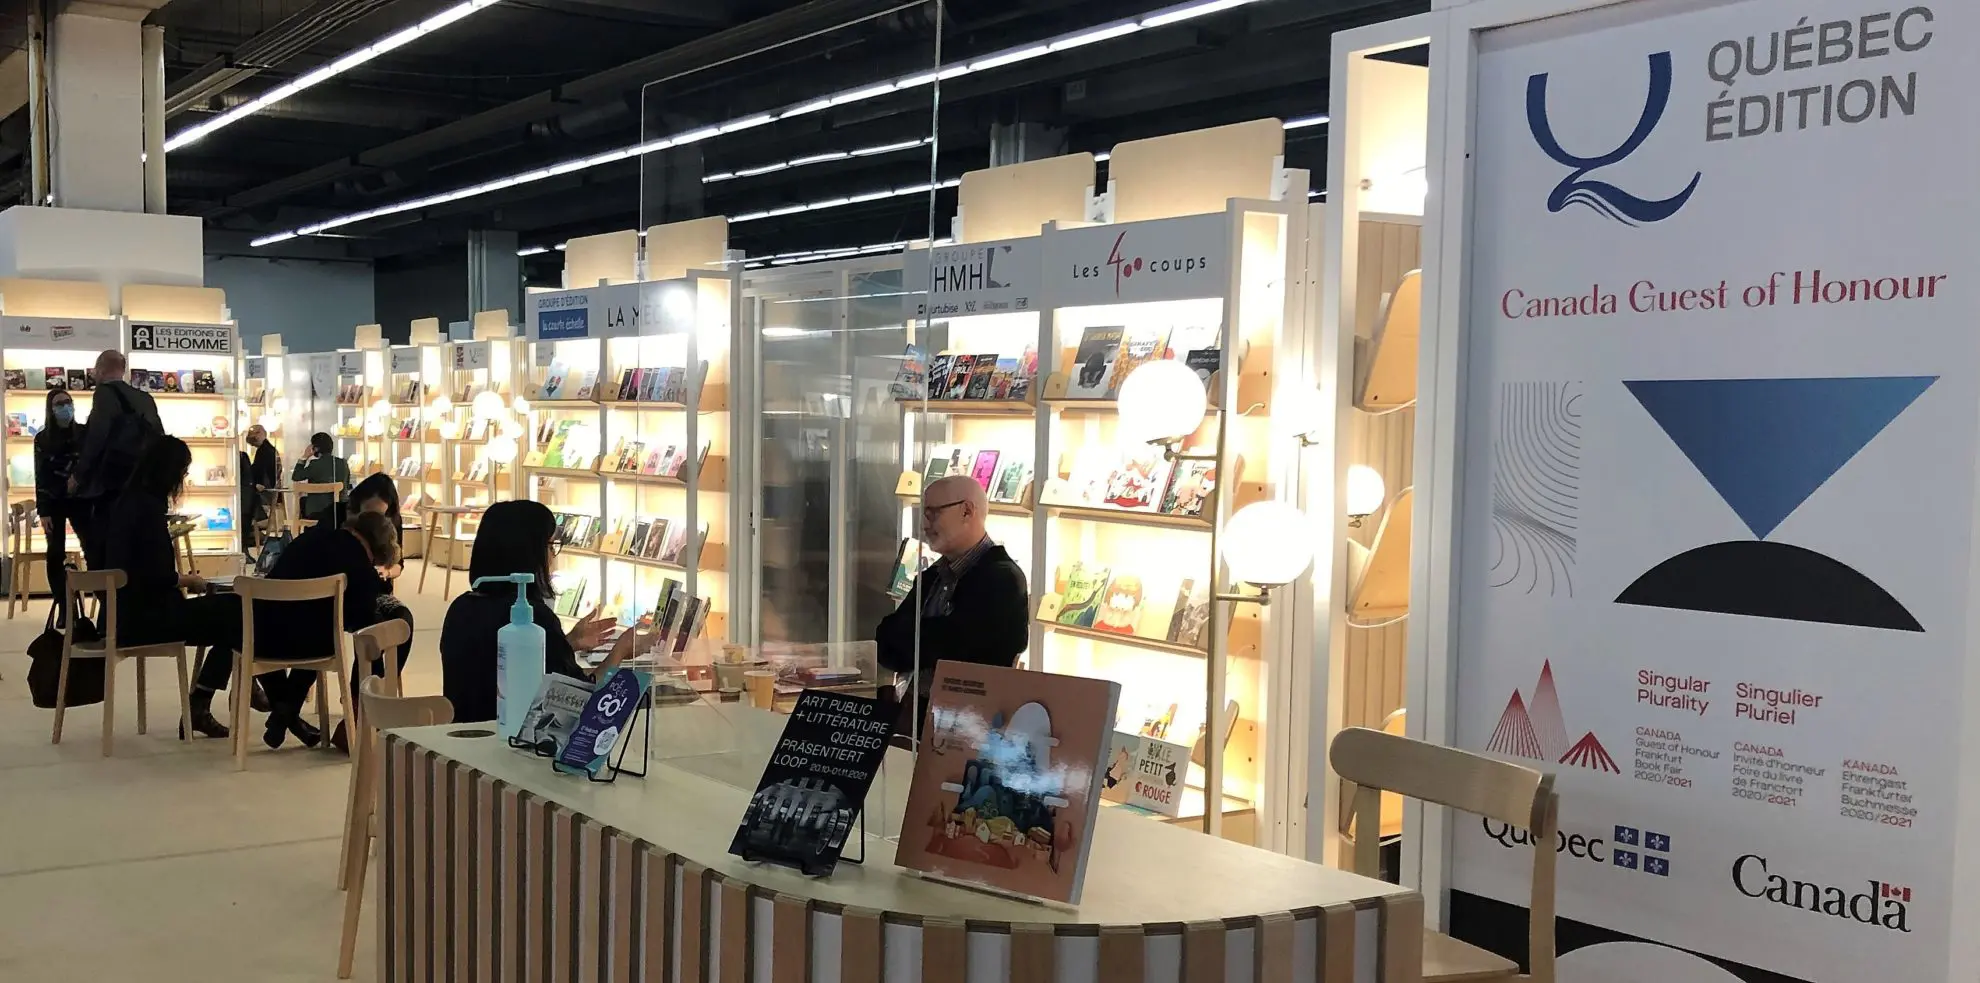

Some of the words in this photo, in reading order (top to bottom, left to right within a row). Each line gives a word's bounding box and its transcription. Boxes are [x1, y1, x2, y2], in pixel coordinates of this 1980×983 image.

[1707, 5, 1935, 86] QUÉBEC
[1705, 71, 1918, 142] ÉDITION
[1150, 256, 1207, 273] coups
[934, 262, 983, 293] HMH
[538, 298, 559, 309] GROUPE
[1502, 284, 1617, 320] Canada
[1628, 279, 1729, 313] Guest
[1742, 271, 1786, 308] of
[1792, 269, 1948, 305] Honour
[608, 307, 625, 328] LA
[155, 326, 171, 336] LES
[216, 330, 229, 339] DE
[156, 338, 229, 350] L'HOMME
[1638, 669, 1711, 693] Singular
[597, 693, 628, 717] GO!
[801, 695, 828, 708] ART
[828, 699, 873, 716] PUBLIC
[1637, 689, 1709, 716] Plurality
[1736, 682, 1823, 708] Singulier
[1735, 702, 1795, 725] Pluriel
[830, 731, 882, 750] QUÉBEC
[1636, 726, 1682, 741] CANADA
[780, 738, 864, 763] PRÄSENTIERT
[1635, 737, 1666, 750] Guest
[1667, 742, 1679, 752] of
[1680, 745, 1720, 759] Honour
[1635, 748, 1682, 764] Frankfurt
[1733, 741, 1784, 758] CANADA
[774, 753, 808, 768] LOOP
[1139, 759, 1164, 776] PETIT
[1634, 758, 1661, 772] Book
[1663, 763, 1683, 775] Fair
[1765, 758, 1826, 777] d'honneur
[1843, 759, 1899, 776] KANADA
[1634, 770, 1692, 788] 2020/2021
[1733, 764, 1760, 778] Foire
[1762, 769, 1777, 780] du
[1779, 772, 1803, 785] livre
[1842, 771, 1907, 790] Ehrengast
[1142, 784, 1172, 805] ROUGE
[1732, 776, 1747, 787] de
[1750, 778, 1803, 796] Francfort
[1841, 783, 1913, 803] Frankfurter
[1732, 787, 1796, 807] 2020/2021
[1840, 794, 1918, 817] Buchmesse
[1840, 806, 1912, 828] 2020/2021
[1483, 816, 1605, 863] Quec
[1731, 854, 1912, 933] Canada
